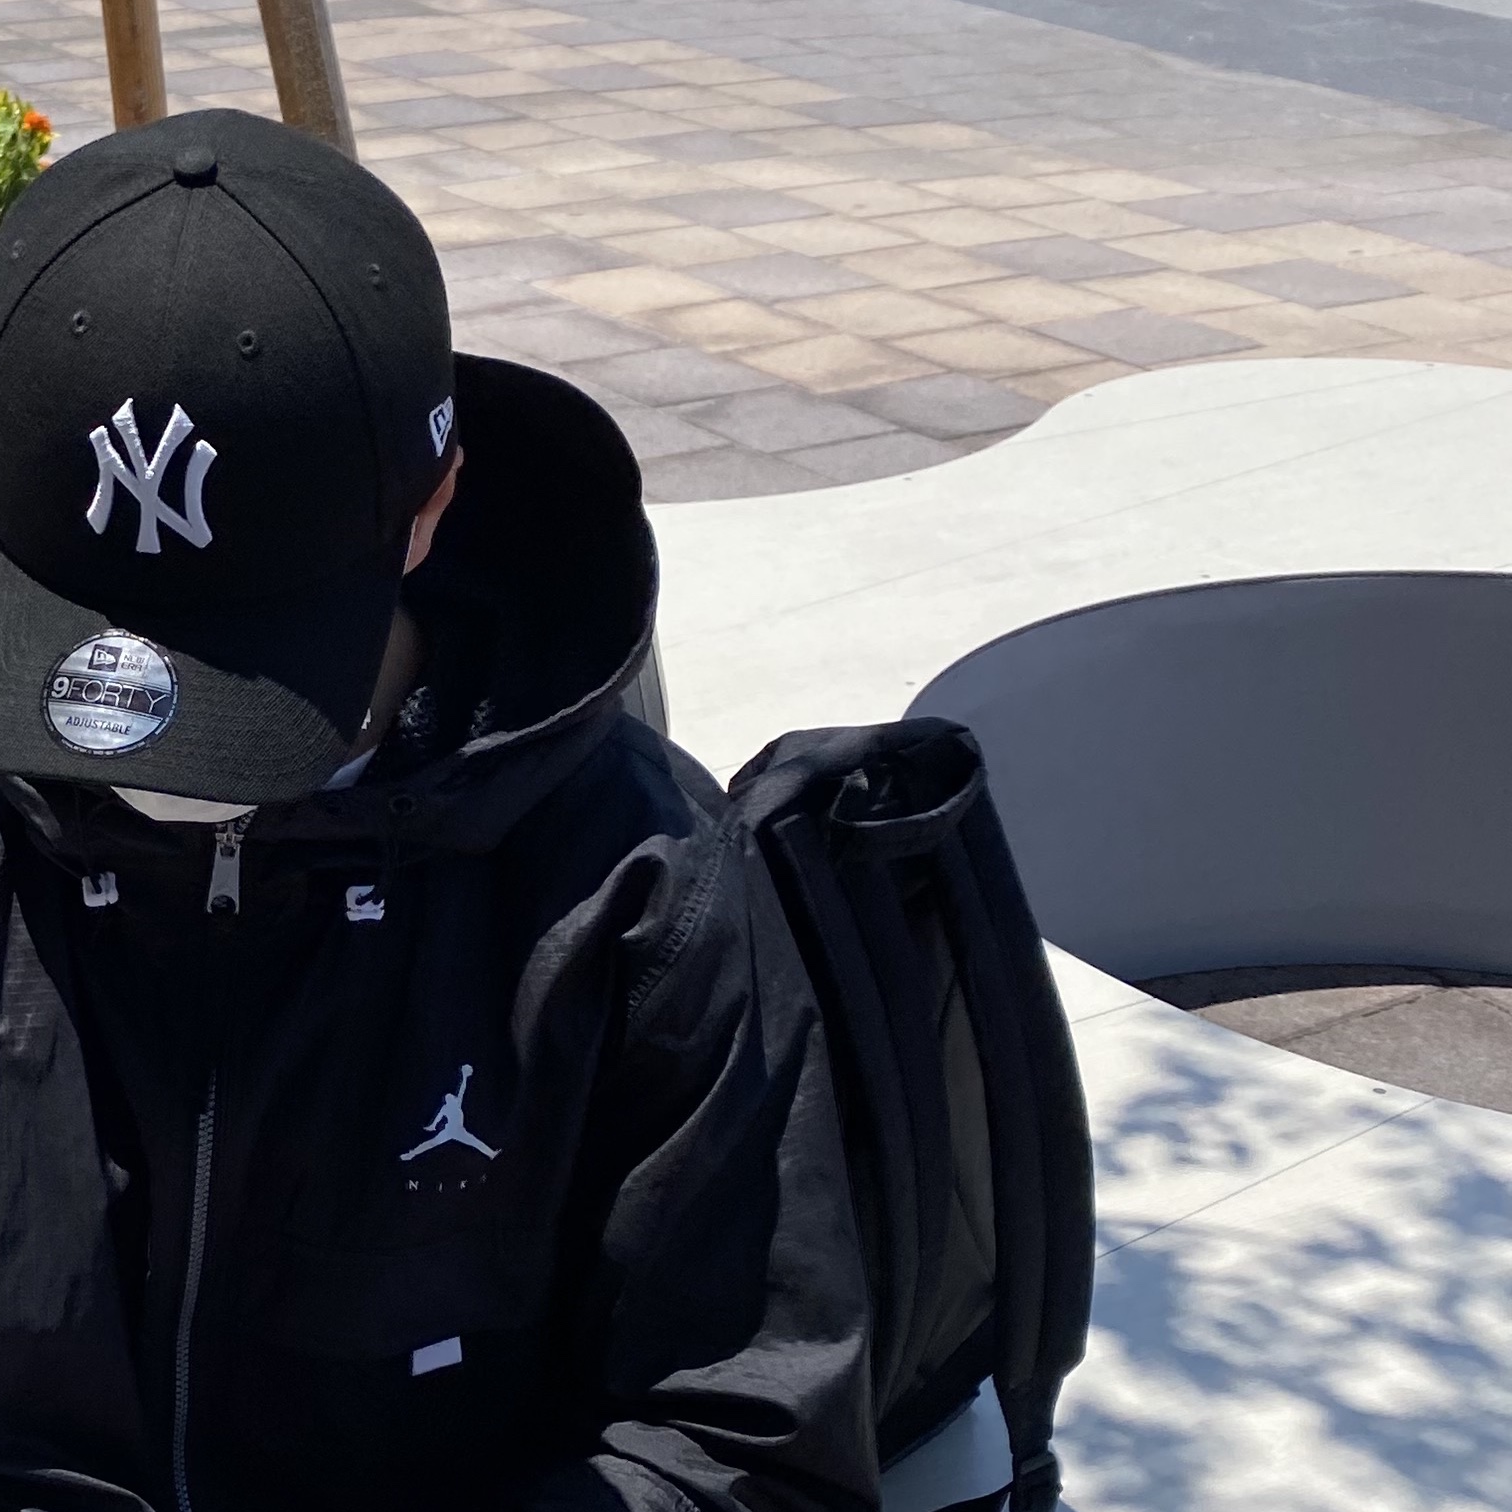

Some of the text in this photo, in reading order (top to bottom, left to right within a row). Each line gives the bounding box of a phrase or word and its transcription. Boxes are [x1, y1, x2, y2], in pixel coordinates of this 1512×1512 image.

[121, 662, 143, 671] ERA
[51, 676, 170, 713] 9FORTY
[65, 716, 131, 735] ADJUSTABLE
[407, 1173, 487, 1193] NIK
